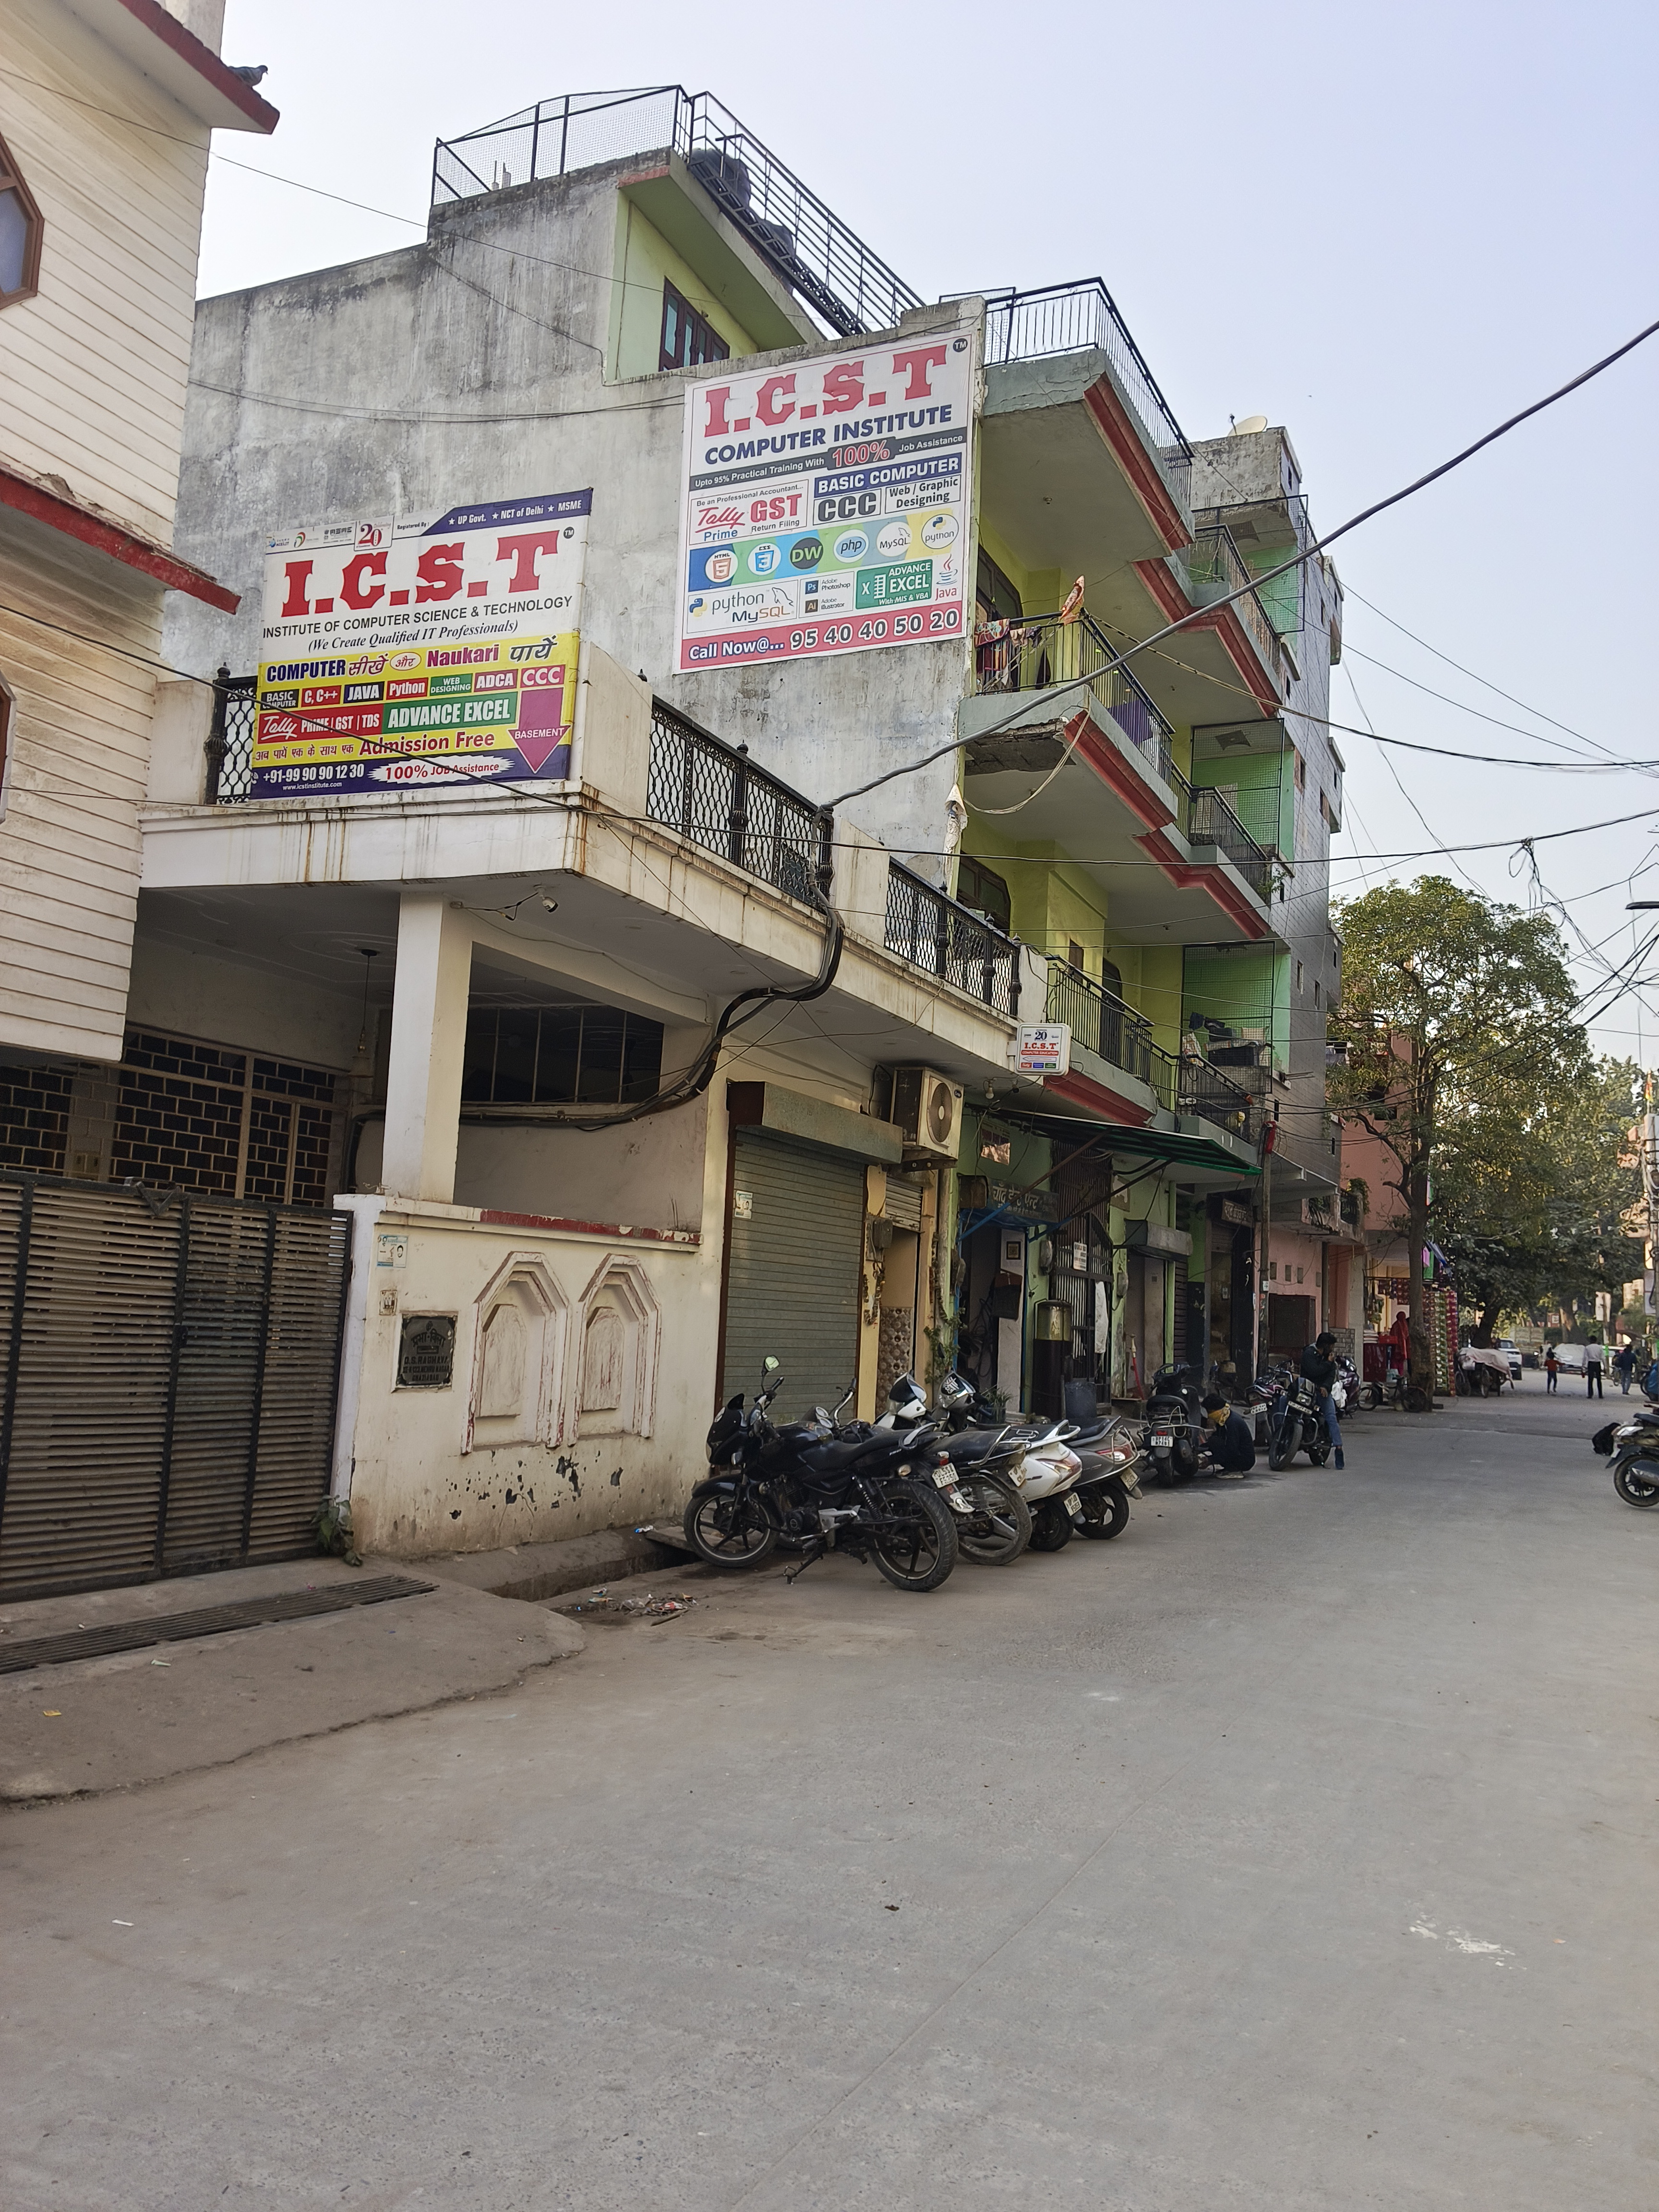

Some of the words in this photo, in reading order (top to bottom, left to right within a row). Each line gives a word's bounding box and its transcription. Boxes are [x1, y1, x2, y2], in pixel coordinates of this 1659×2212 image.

[955, 340, 967, 349] TM
[705, 344, 947, 437] I.C.S.T
[705, 428, 826, 465] COMPUTER
[834, 404, 951, 442] INSTITUTE
[695, 479, 712, 488] Upto
[714, 476, 730, 484] 95%
[731, 468, 767, 481] Practical
[769, 461, 803, 474] Training
[805, 457, 825, 468] With
[832, 440, 890, 468] 100%
[899, 444, 914, 452] Job
[916, 435, 962, 449] Assistance
[817, 474, 865, 494] BASIC
[869, 457, 959, 485] COMPUTER
[889, 485, 910, 497] Web
[919, 477, 958, 492] Graphic
[557, 500, 582, 512] MSME
[717, 491, 758, 503] Professional
[896, 492, 950, 508] Designing
[501, 509, 515, 519] NCT
[516, 508, 524, 517] of
[526, 505, 544, 516] Delhi
[750, 493, 802, 523] GST
[817, 492, 877, 522] CCC
[457, 516, 468, 525] UP
[469, 514, 487, 523] Govt.
[696, 506, 745, 531] Tally
[751, 523, 776, 533] Return
[779, 520, 800, 529] Filing
[358, 524, 382, 547] 20
[704, 529, 738, 541] Prime
[879, 537, 911, 549] MySQL
[925, 531, 954, 543] python
[792, 545, 822, 563] DW
[841, 540, 862, 554] php
[715, 562, 728, 574] 5
[758, 553, 771, 568] 3
[888, 562, 931, 577] ADVANCE
[281, 530, 560, 617] I.C.S.T
[890, 574, 929, 593] EXCEL
[712, 591, 764, 615] python
[935, 588, 957, 601] Java
[263, 623, 321, 638] INSTITUTE
[324, 621, 340, 632] OF
[343, 613, 410, 630] COMPUTER
[413, 607, 467, 623] SCIENCE
[471, 606, 479, 617] &
[483, 596, 573, 616] TECHNOLOGY
[732, 605, 791, 623] MySQL
[308, 639, 329, 653] (We
[332, 637, 366, 649] Create
[369, 629, 422, 648] Qualified
[422, 628, 437, 640] IT
[438, 619, 518, 640] Professionals)
[689, 643, 718, 660] Call
[791, 629, 817, 649] 95
[825, 625, 852, 644] 40
[860, 620, 887, 639] 40
[895, 615, 922, 635] 50
[931, 609, 958, 629] 20
[427, 644, 500, 667] Naukari
[510, 635, 558, 662] पायें
[267, 659, 346, 682] COMPUTER
[348, 653, 389, 676] सीखें
[395, 655, 416, 668] और
[443, 677, 460, 685] WEB
[476, 673, 514, 688] ADCA
[522, 667, 561, 685] CCC
[266, 691, 293, 702] BASIC
[347, 685, 380, 701] JAVA
[389, 681, 425, 697] Python
[431, 684, 471, 694] DESIGNING
[263, 700, 296, 709] MPUTER
[387, 703, 461, 729] ADVANCE
[463, 698, 510, 722] EXCEL
[261, 715, 298, 740] Tally
[301, 718, 329, 733] PRIME
[336, 716, 354, 730] GST
[361, 713, 380, 728] TDS
[514, 727, 565, 739] BASEMENT
[291, 748, 304, 757] एक
[308, 744, 315, 757] के
[320, 745, 337, 756] साथ
[342, 744, 354, 754] एक
[359, 734, 449, 756] Admission
[456, 731, 495, 748] Free
[264, 769, 301, 783] +91-99
[302, 767, 317, 781] 90
[319, 765, 334, 780] 90
[335, 765, 347, 779] 12
[349, 763, 365, 778] 30
[385, 764, 428, 781] 100%
[452, 763, 499, 774] Assistance
[1034, 1031, 1047, 1040] 20
